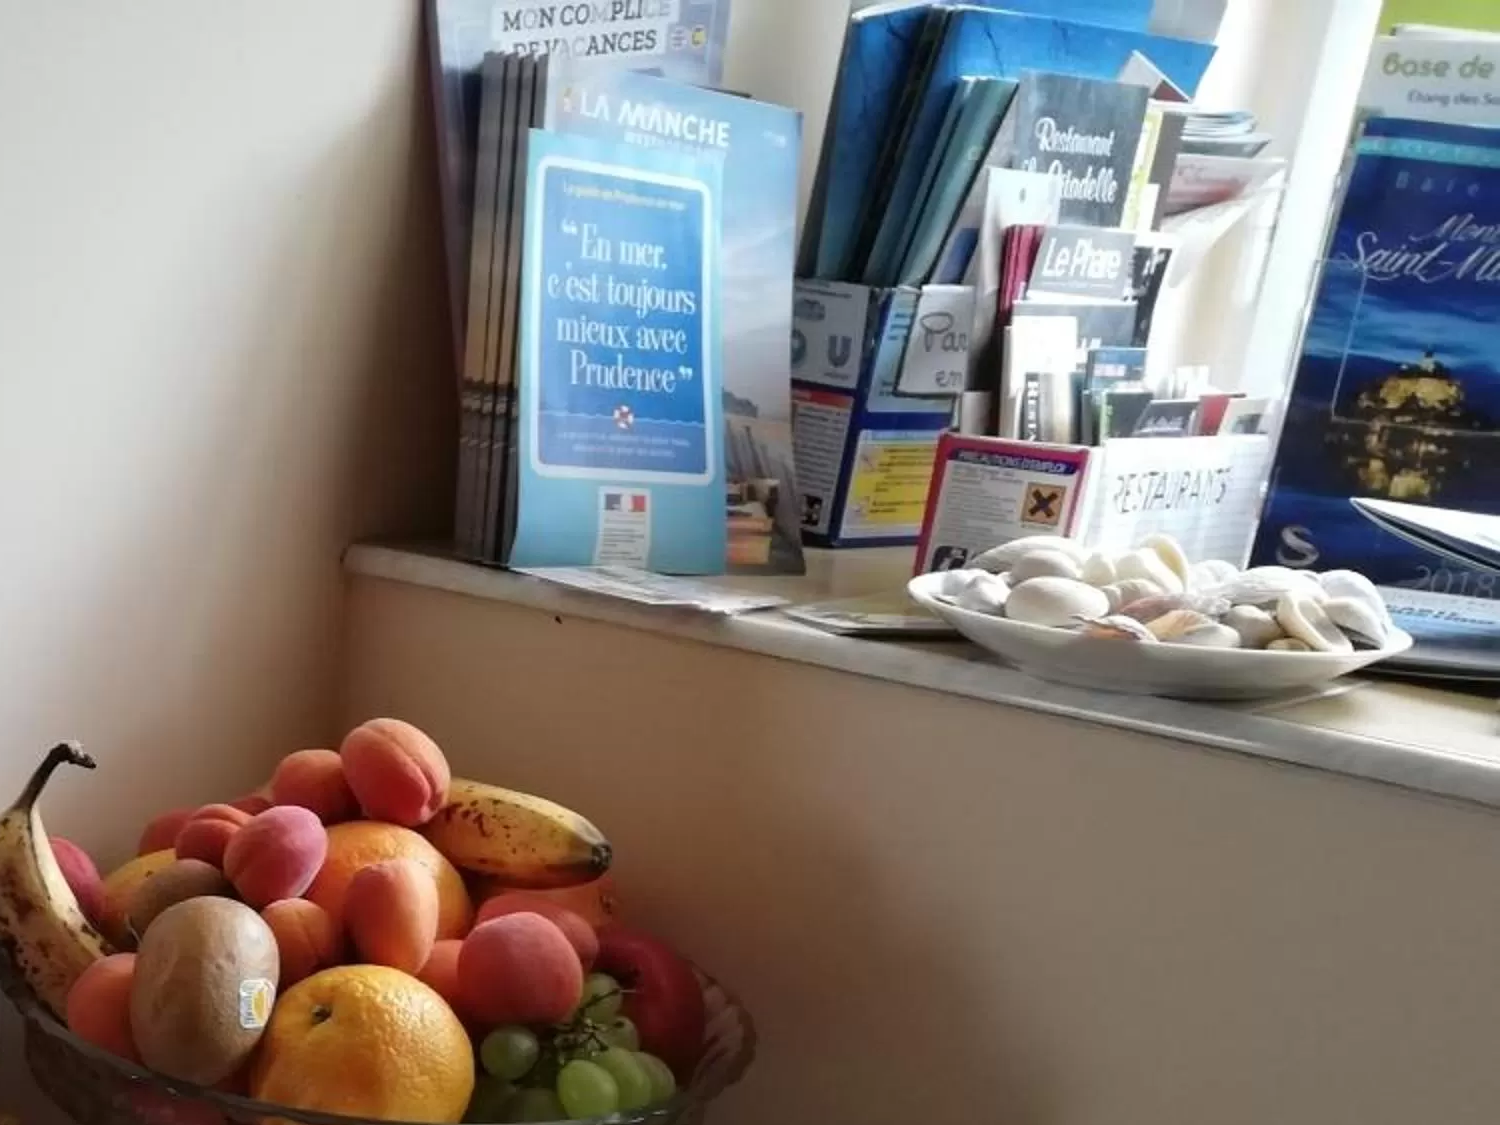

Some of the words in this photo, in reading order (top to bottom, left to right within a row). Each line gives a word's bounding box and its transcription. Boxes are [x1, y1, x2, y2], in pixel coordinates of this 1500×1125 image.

[502, 5, 556, 33] MON
[1459, 54, 1496, 80] de
[580, 95, 611, 121] LA
[619, 100, 732, 148] MANCHE
[1041, 237, 1070, 277] Le
[606, 277, 697, 319] toujours
[555, 315, 630, 349] mieux
[637, 325, 689, 355] avec
